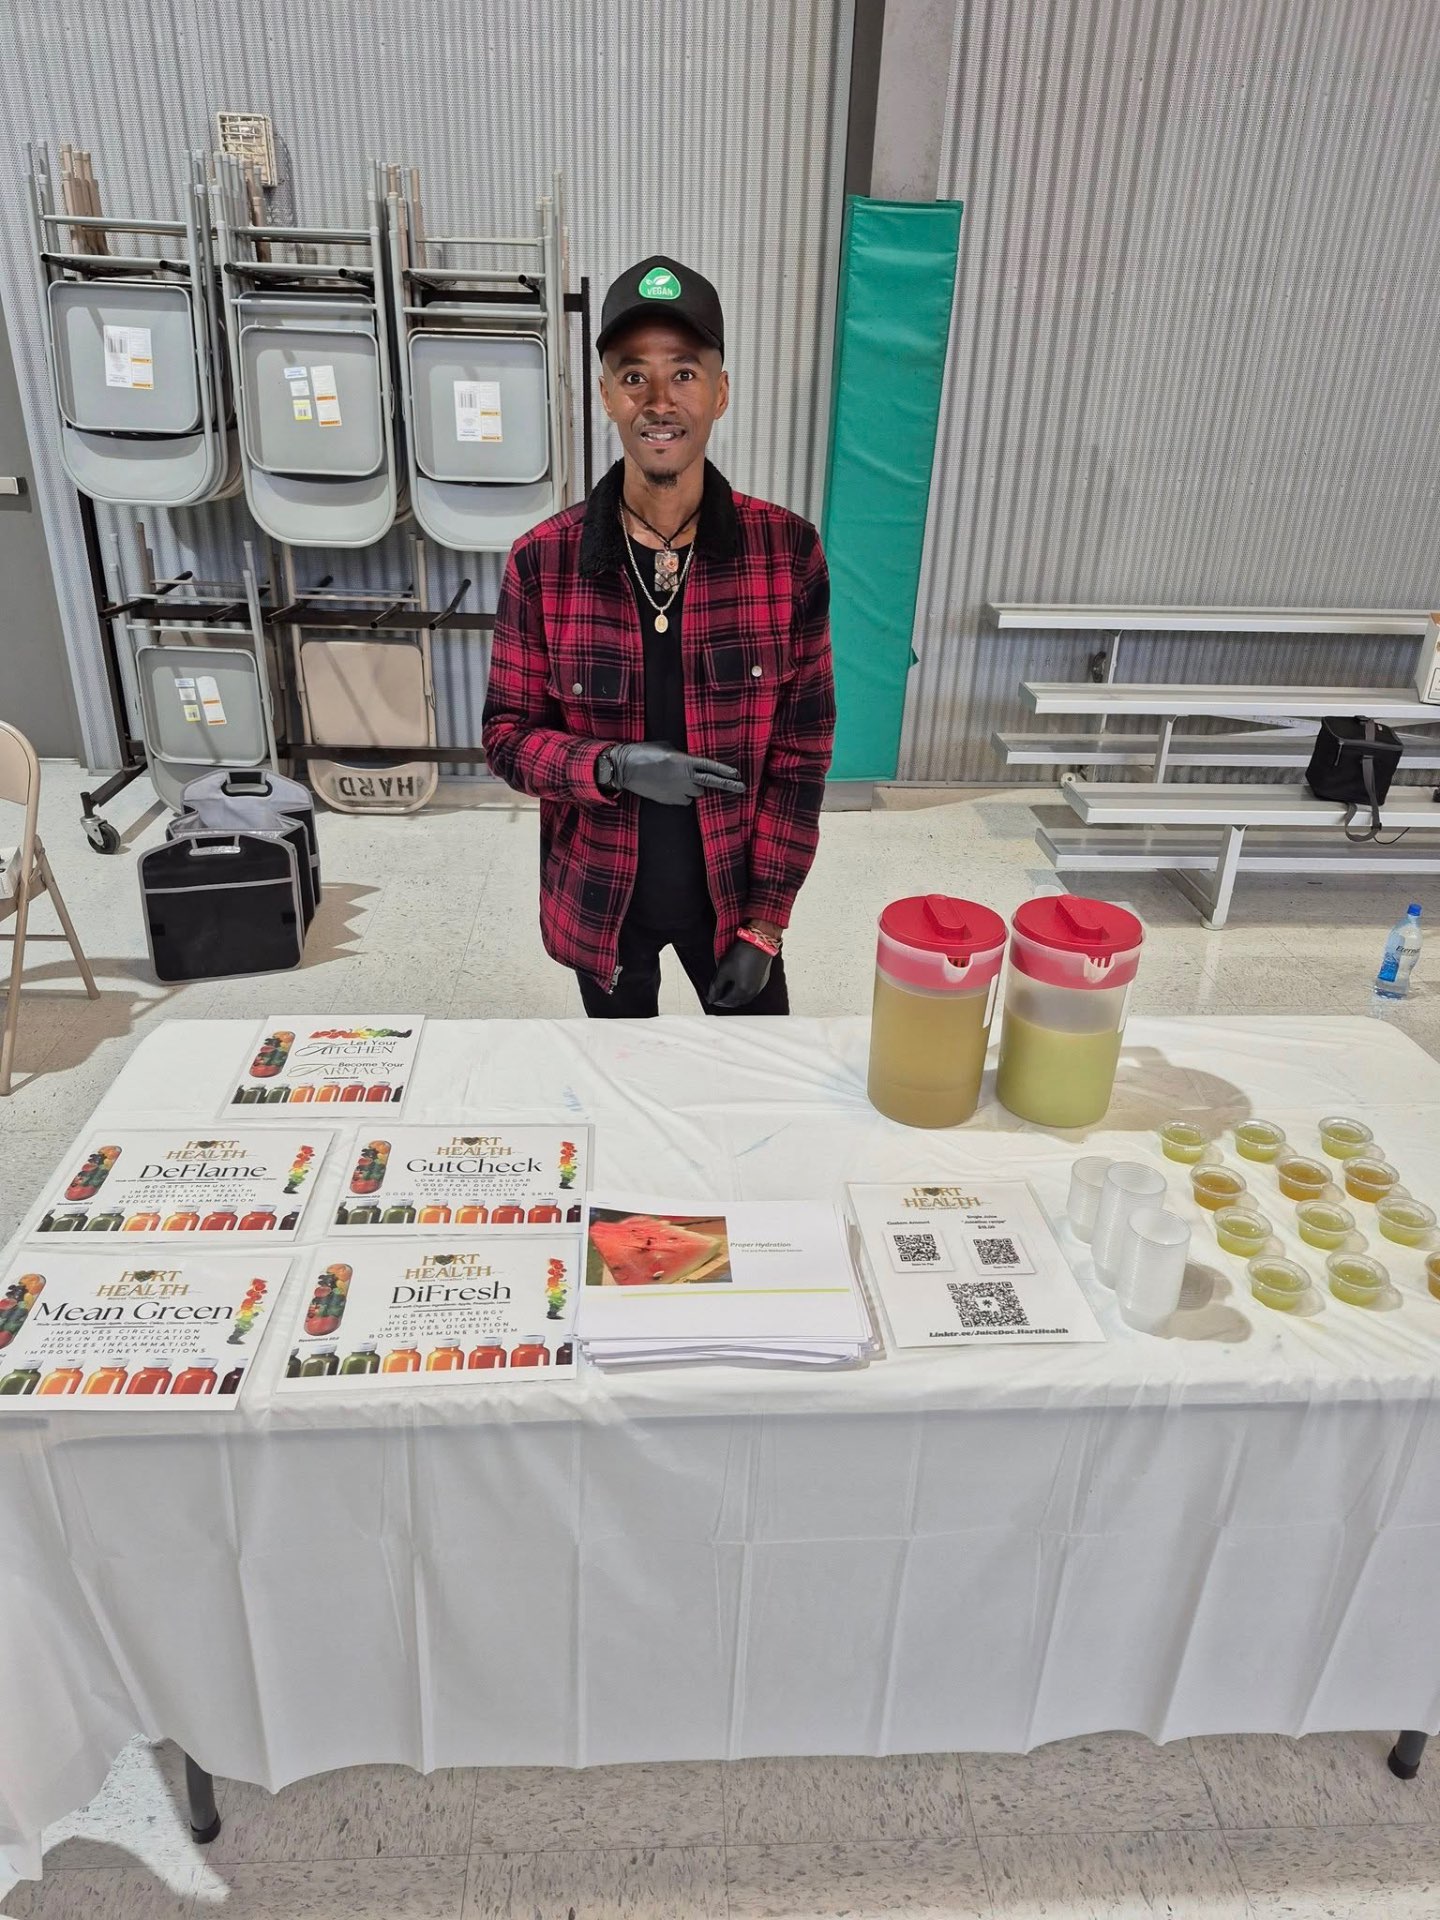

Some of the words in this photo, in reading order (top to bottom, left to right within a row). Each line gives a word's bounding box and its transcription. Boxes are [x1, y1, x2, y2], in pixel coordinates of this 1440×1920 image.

[646, 286, 674, 297] VEGAN
[165, 1149, 248, 1160] HEALTH
[436, 1146, 513, 1156] HEALTH
[139, 1162, 268, 1180] DeFlame
[406, 1157, 543, 1174] GutCheck
[902, 1196, 982, 1208] HEALTH
[730, 1242, 755, 1250] Proper
[755, 1241, 792, 1250] Hydration
[404, 1265, 492, 1280] HEALTH
[94, 1283, 191, 1297] HEALTH
[391, 1281, 512, 1304] DiFresh
[33, 1302, 125, 1321] Mean
[132, 1301, 234, 1321] Green
[388, 1311, 453, 1319] INCREASES
[459, 1309, 504, 1317] ENERGY
[379, 1324, 440, 1332] IMPROVES
[445, 1321, 510, 1329] DIGESTION
[368, 1332, 414, 1340] BOOSTS
[474, 1327, 518, 1335] SYSTEM
